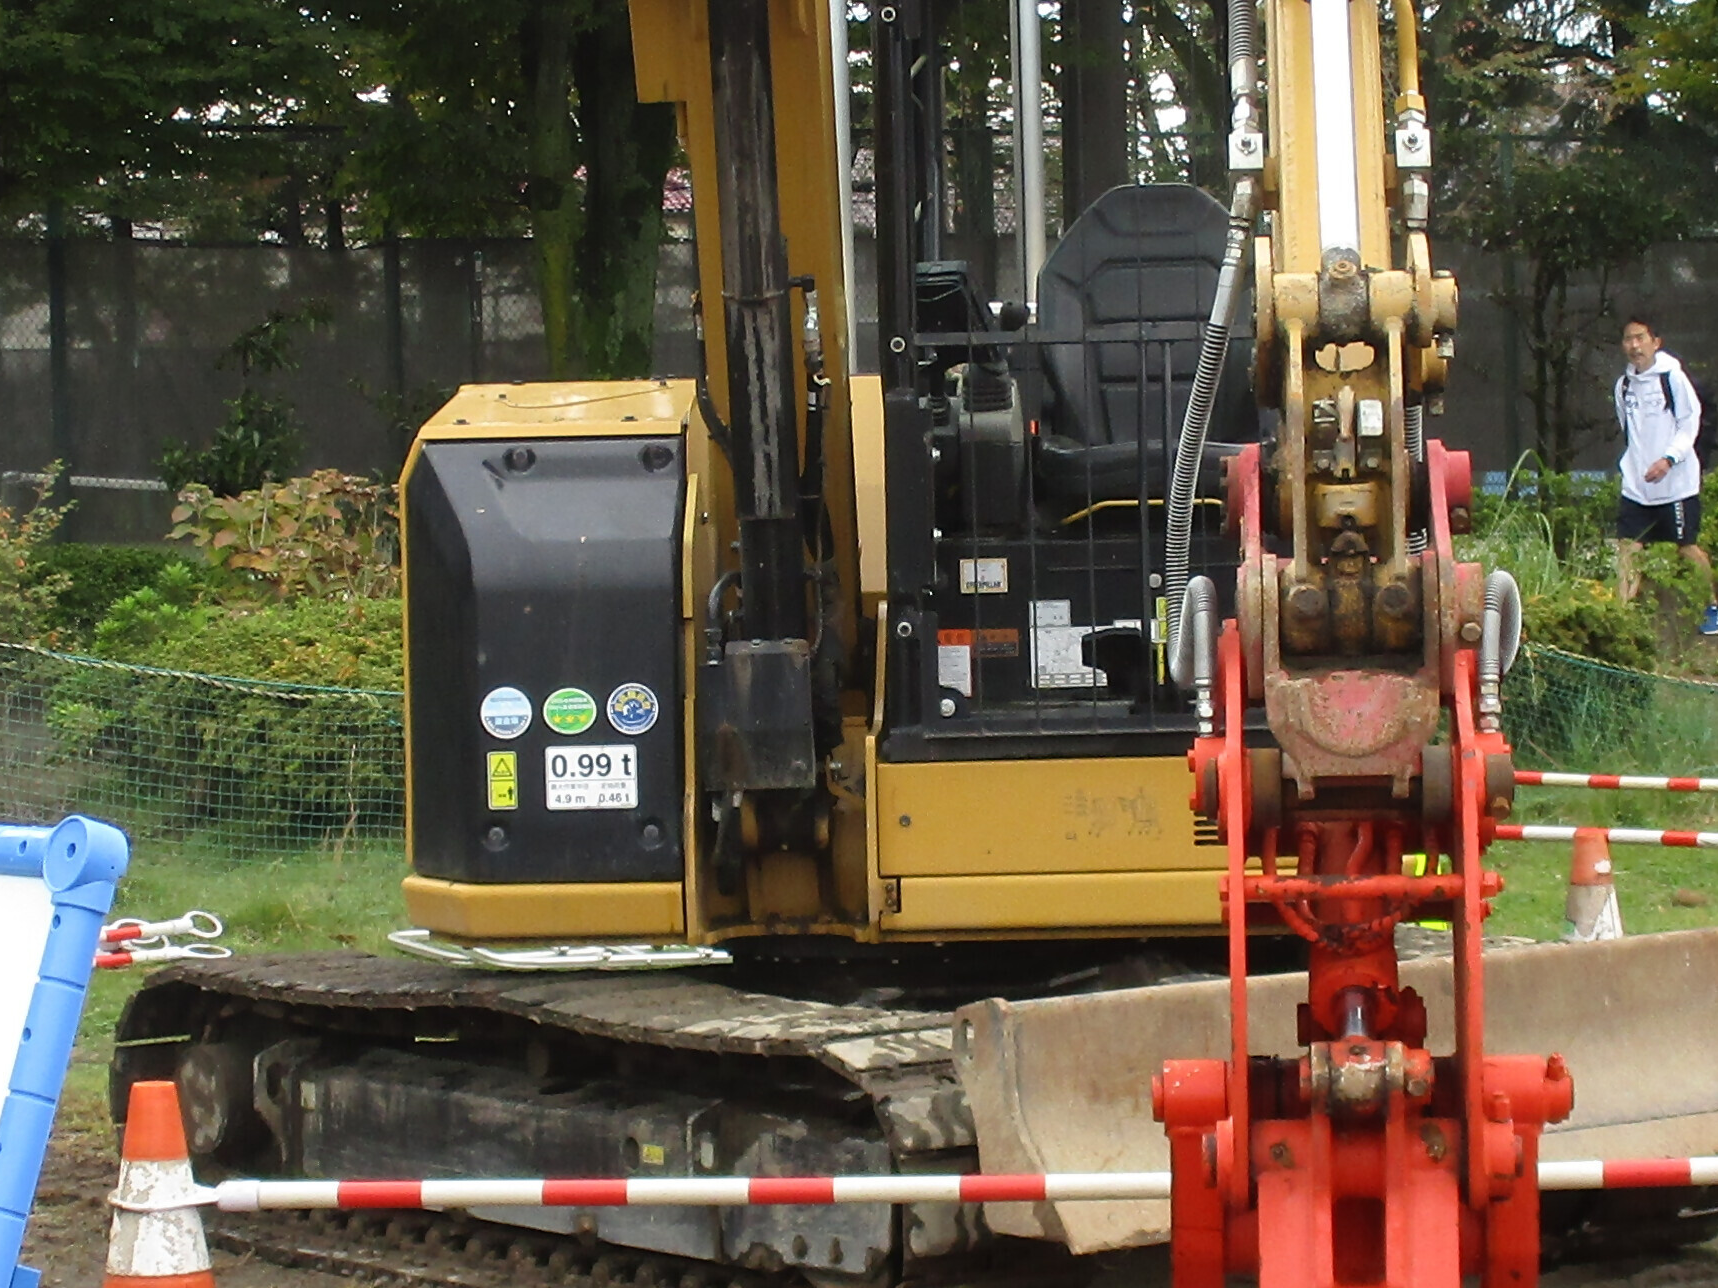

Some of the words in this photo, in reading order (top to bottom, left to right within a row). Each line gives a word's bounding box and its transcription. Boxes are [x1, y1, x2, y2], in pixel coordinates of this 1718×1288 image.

[551, 753, 612, 778] 0.99
[621, 753, 632, 777] t
[555, 794, 572, 803] 4.9
